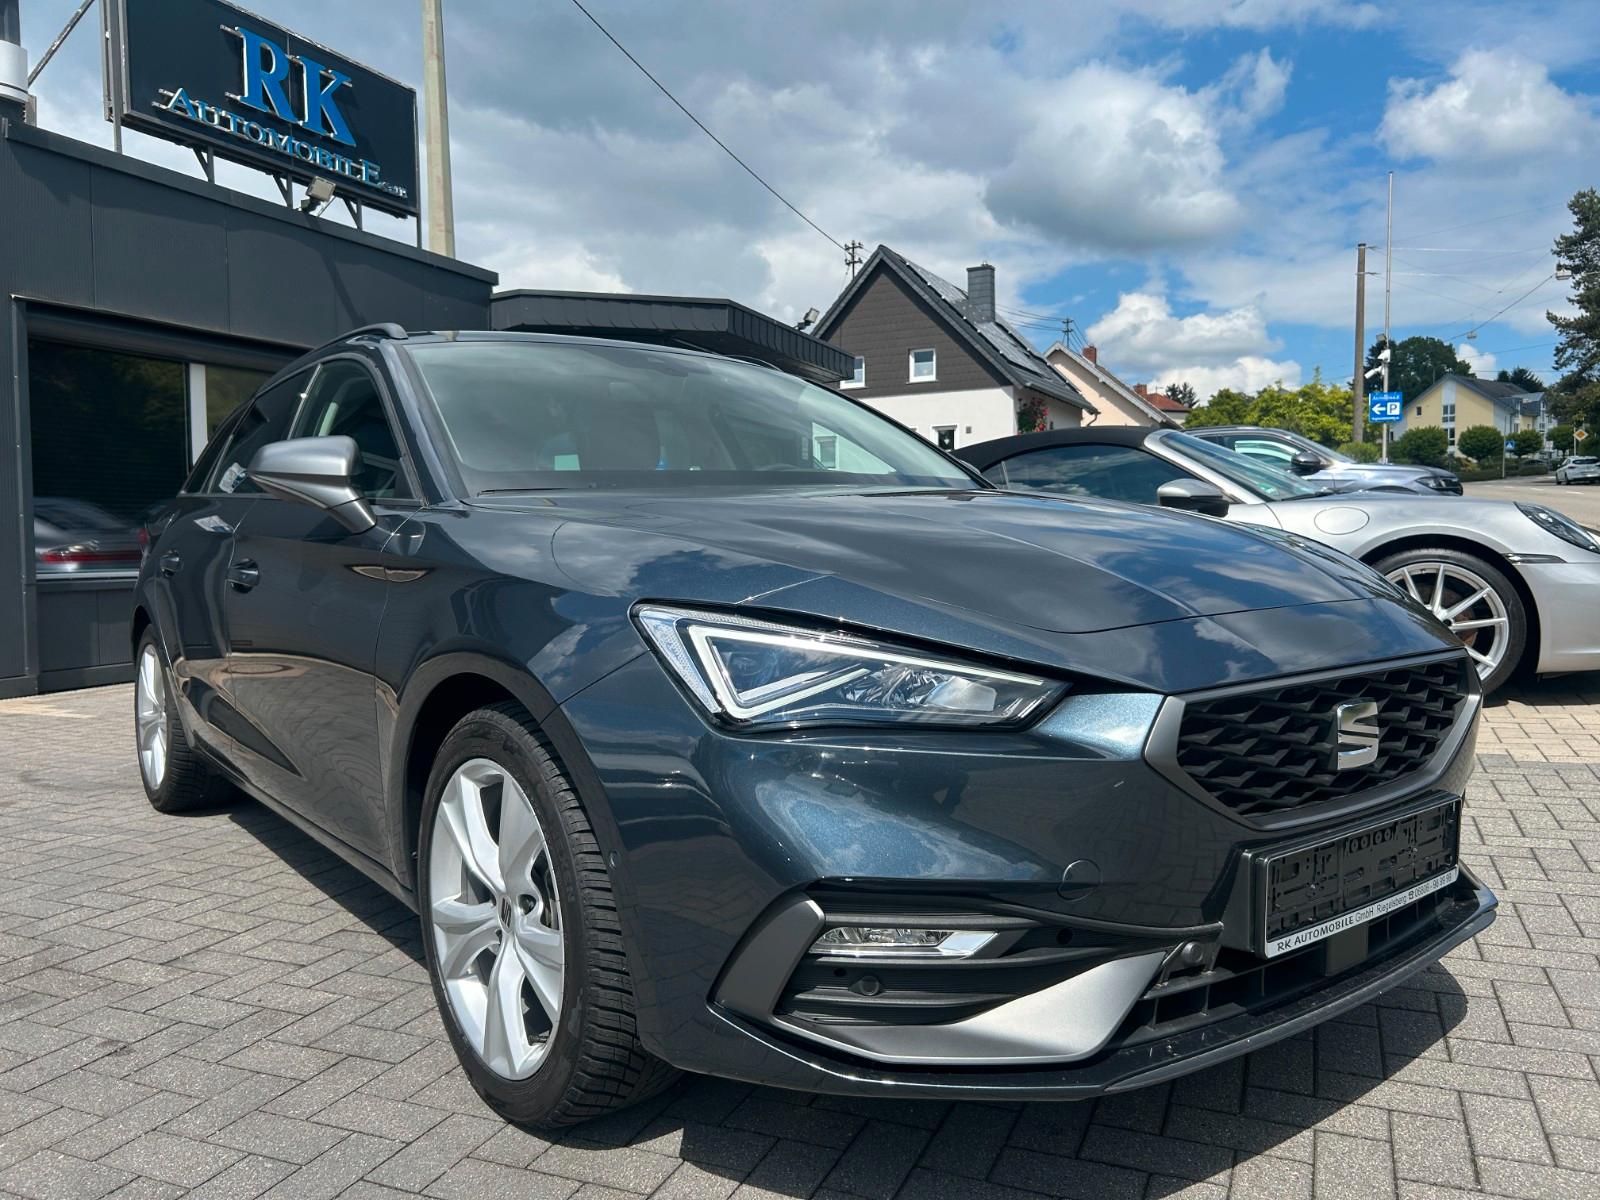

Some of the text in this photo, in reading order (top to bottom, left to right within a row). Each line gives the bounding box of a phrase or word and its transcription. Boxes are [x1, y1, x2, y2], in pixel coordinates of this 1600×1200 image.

[233, 25, 357, 148] RK
[155, 87, 381, 185] AUTOMOBILE
[1277, 940, 1292, 952] RK
[1294, 915, 1354, 946] AUTOMOBILE
[1355, 906, 1374, 922] GmbH
